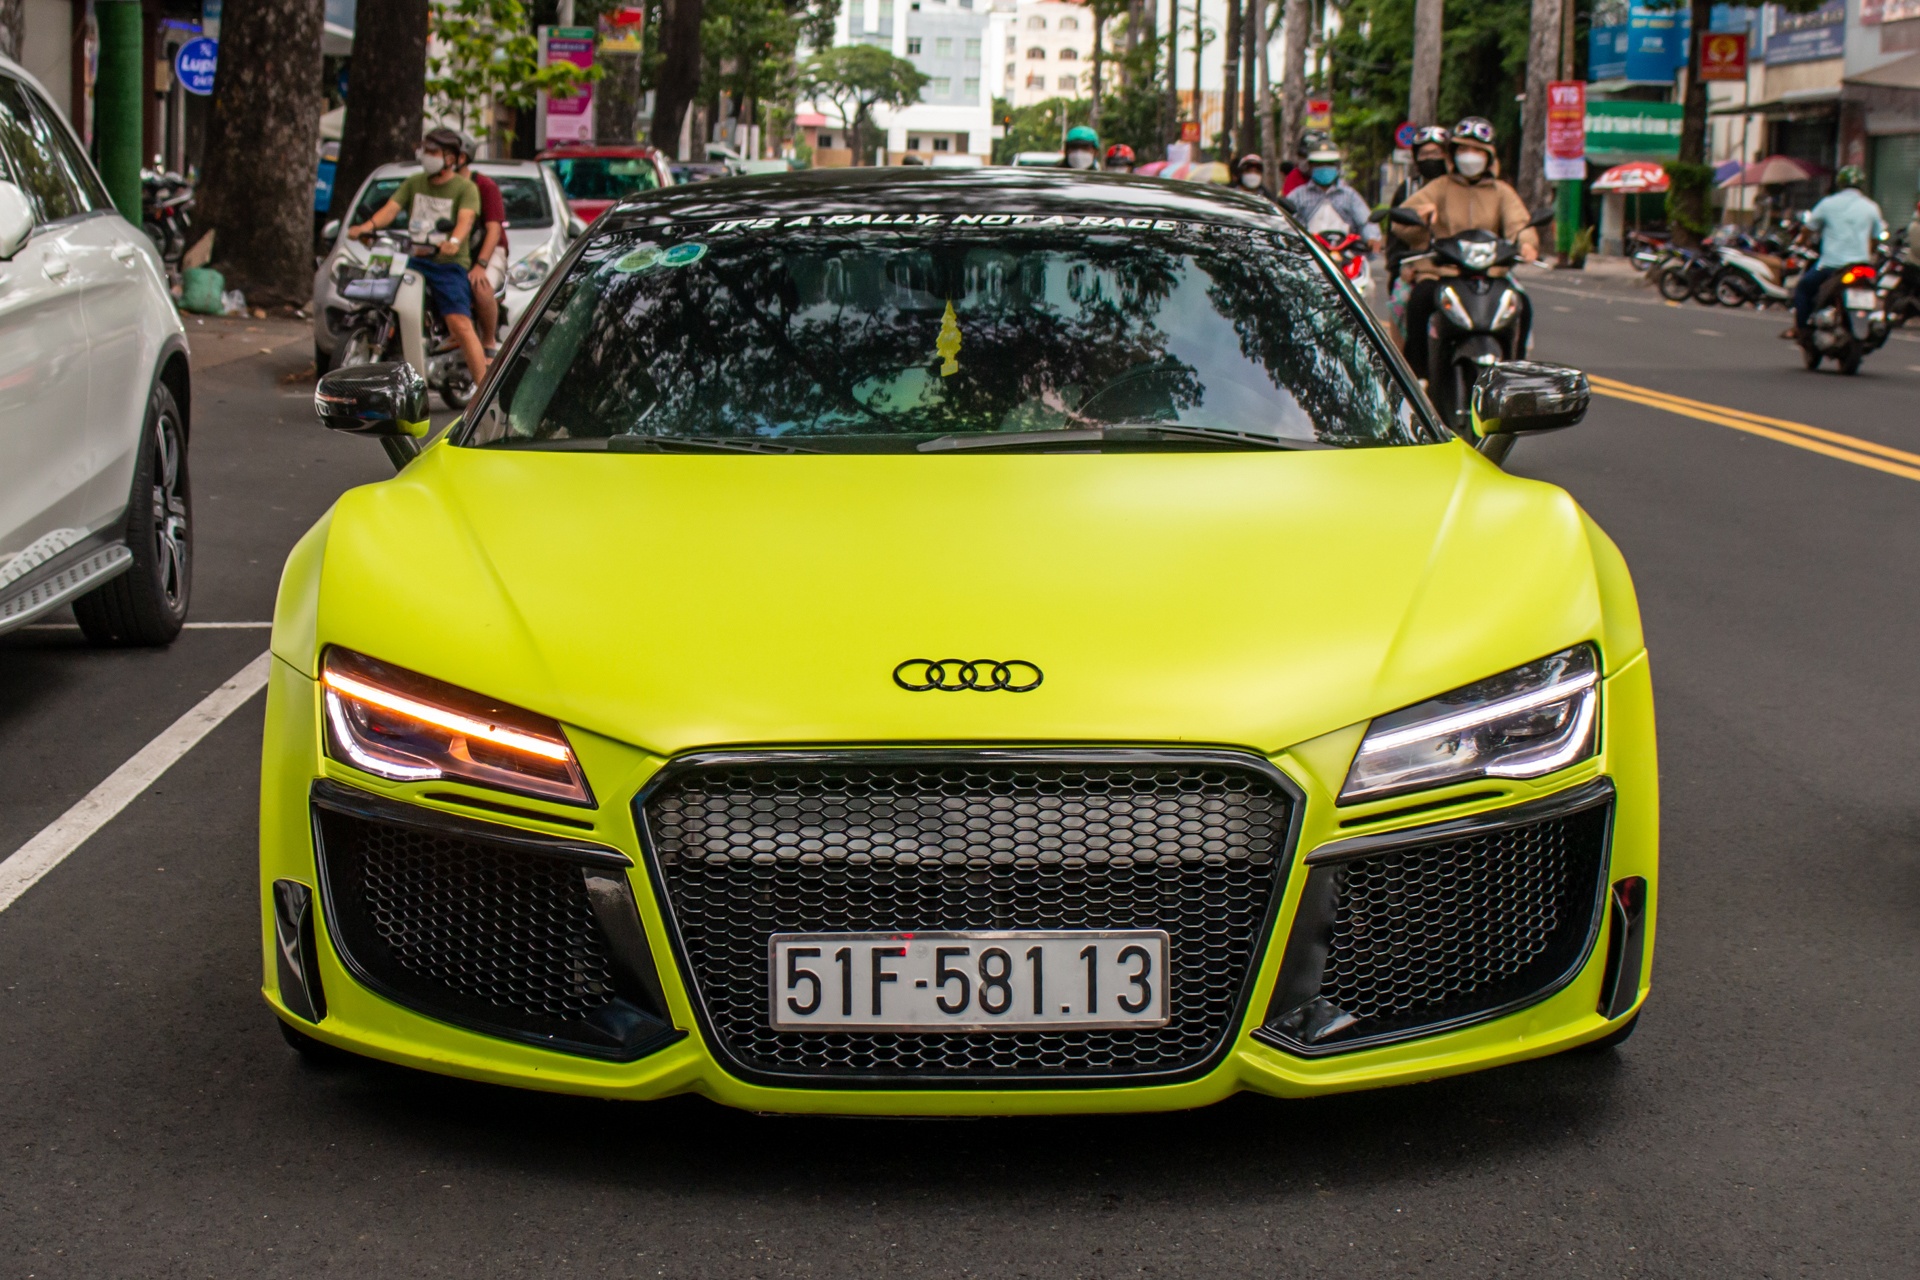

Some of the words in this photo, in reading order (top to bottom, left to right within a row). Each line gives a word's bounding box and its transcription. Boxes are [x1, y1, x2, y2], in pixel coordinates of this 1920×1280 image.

[707, 217, 781, 234] IT'S
[783, 215, 812, 227] A
[952, 213, 1034, 225] NOT
[1038, 214, 1065, 226] A
[1079, 215, 1177, 231] RACE
[786, 945, 1152, 1016] 51F-581.13
